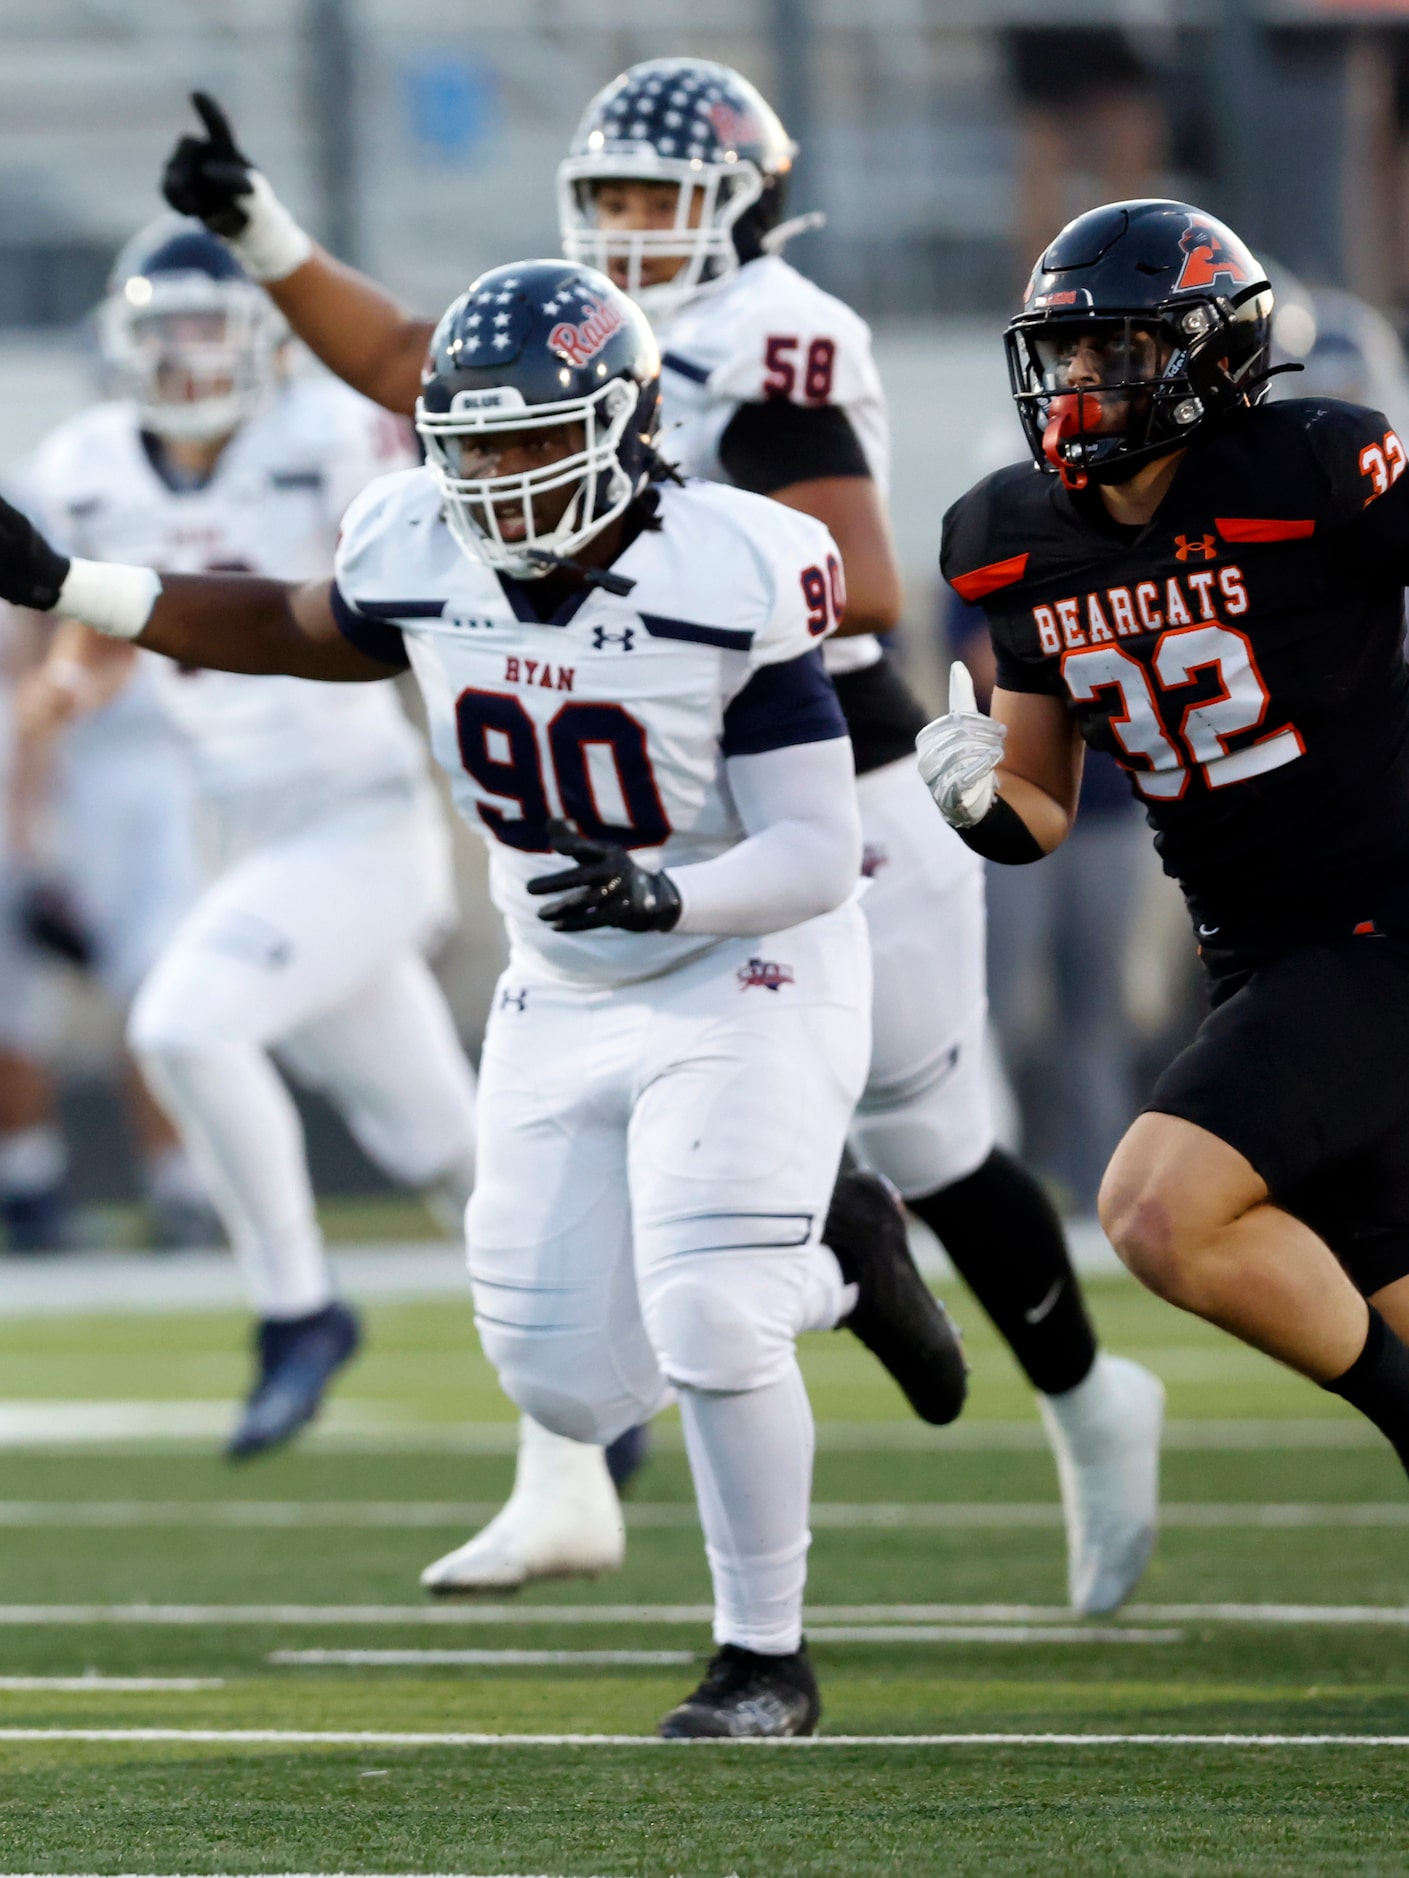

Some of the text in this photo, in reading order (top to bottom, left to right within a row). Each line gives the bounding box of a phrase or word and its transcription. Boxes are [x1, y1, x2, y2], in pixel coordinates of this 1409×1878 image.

[762, 335, 836, 402] 58
[1358, 431, 1407, 511] 32
[800, 552, 846, 637] 90
[1032, 565, 1250, 656] BEARCATS
[505, 656, 575, 692] RYAN
[1060, 620, 1307, 801] 32
[455, 686, 673, 854] 90
